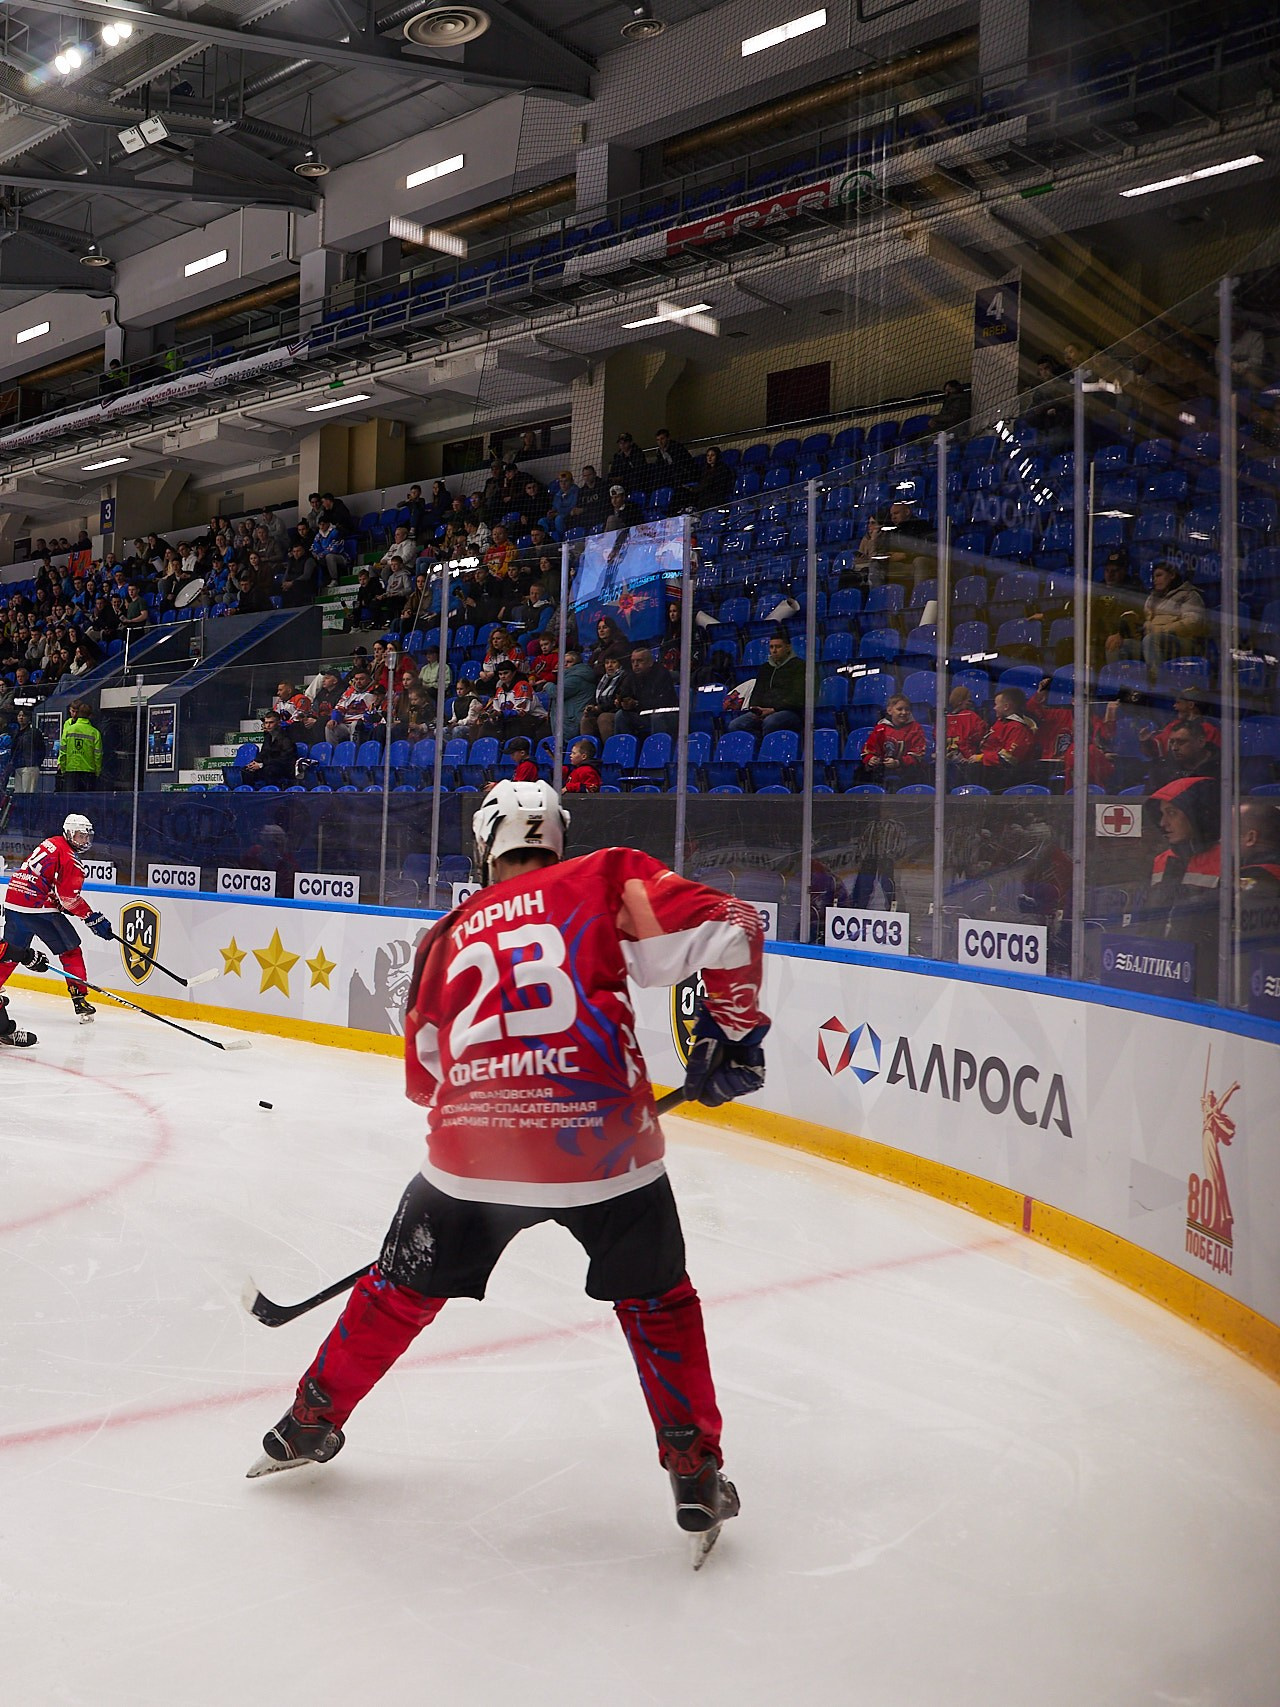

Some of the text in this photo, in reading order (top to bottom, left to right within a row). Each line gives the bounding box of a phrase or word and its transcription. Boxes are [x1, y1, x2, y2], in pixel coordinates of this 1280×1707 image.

[986, 292, 1005, 320] 4
[105, 503, 111, 520] 3
[524, 820, 544, 839] Z
[450, 889, 545, 951] ТЮРИН
[1125, 953, 1181, 980] БАЛТИКА
[446, 923, 578, 1060] 23
[448, 1046, 580, 1087] ФЕНИКС
[886, 1036, 1073, 1139] АЛРОСА
[519, 1117, 548, 1129] МЧС
[550, 1116, 603, 1128] РОССИИ
[1187, 1173, 1213, 1228] 80
[1185, 1228, 1233, 1276] ПОБЕДА!
